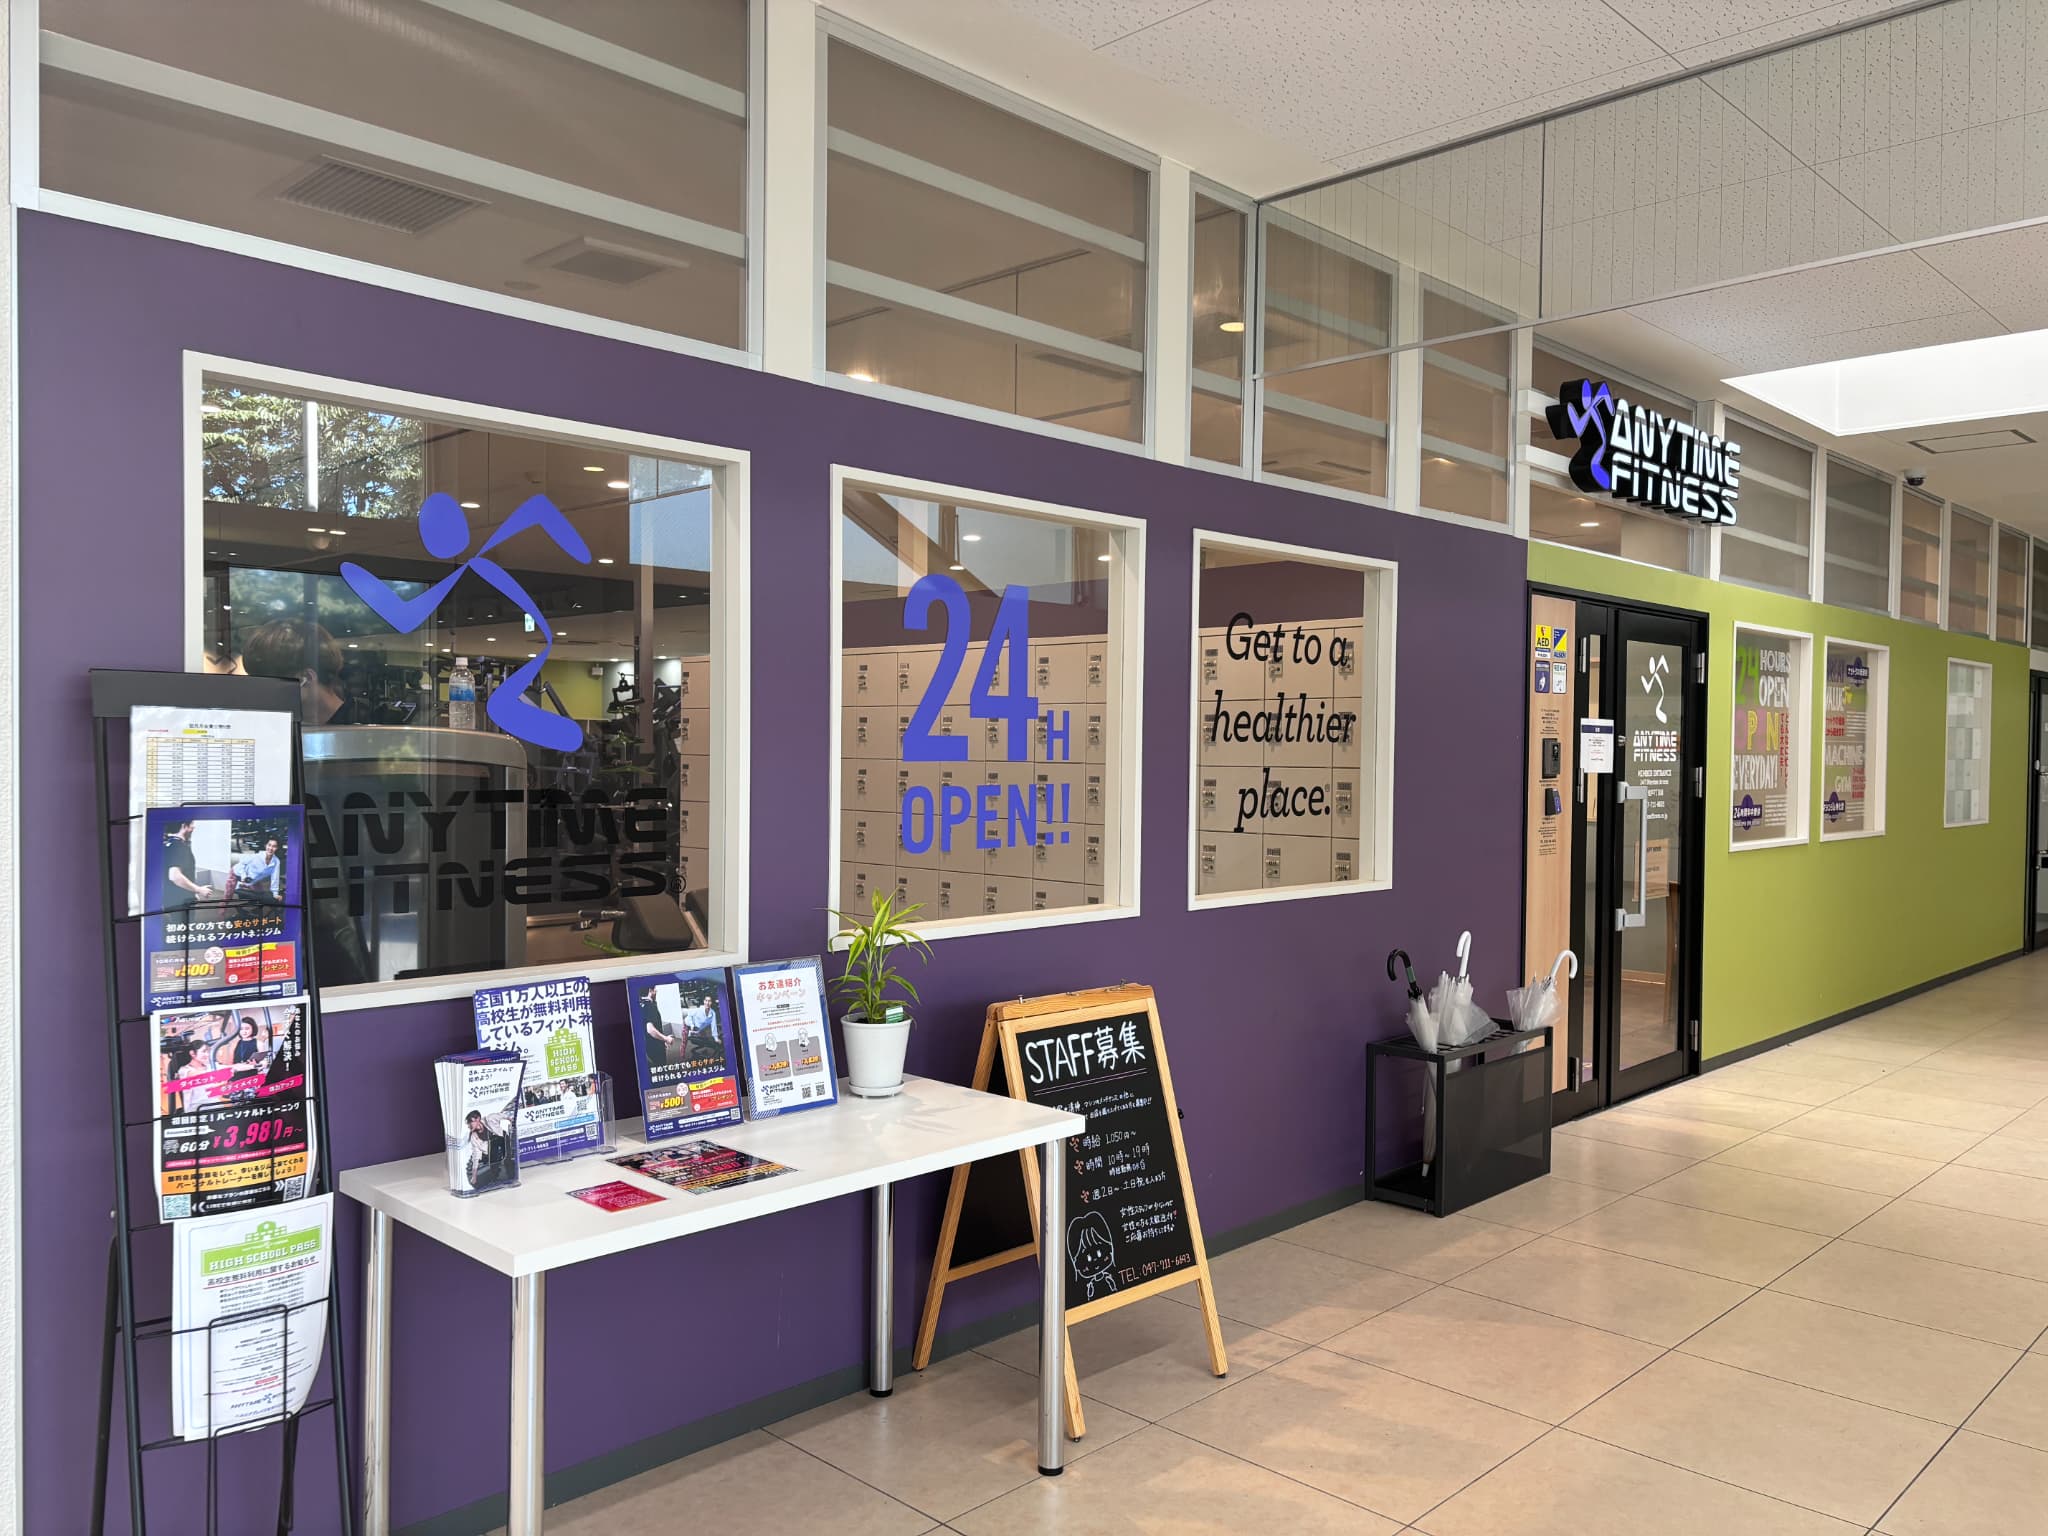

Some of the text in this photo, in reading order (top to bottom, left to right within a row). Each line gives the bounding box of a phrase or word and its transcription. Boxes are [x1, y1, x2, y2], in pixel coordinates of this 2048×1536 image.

[1610, 399, 1741, 489] ANYTIME
[1611, 452, 1738, 525] FITNESS
[1226, 612, 1348, 667] Get to a
[1537, 637, 1550, 647] AED
[1736, 647, 1759, 704] 24
[1760, 649, 1791, 673] HOURS
[1759, 675, 1790, 707] OPEN
[1211, 689, 1356, 743] healthier
[1633, 730, 1677, 747] ANYTIME
[1633, 748, 1677, 762] FITNESS
[1733, 754, 1778, 791] EVERYDAY!
[1234, 768, 1331, 833] place.
[901, 783, 1070, 854] OPEN!!
[756, 988, 806, 1002] キャンペーン
[758, 977, 801, 991] お友達紹介
[479, 996, 591, 1025] 高校生が無料利用
[481, 1011, 592, 1043] しているフィットネ
[552, 1047, 576, 1057] HIGH
[1025, 1020, 1146, 1084] STAFF募集
[554, 1064, 578, 1074] PASS
[535, 1105, 565, 1114] ANYTIME
[535, 1110, 565, 1119] FITNESS
[1086, 1156, 1103, 1171] 時間
[208, 1239, 317, 1272] HIGH SCHOOL PASS
